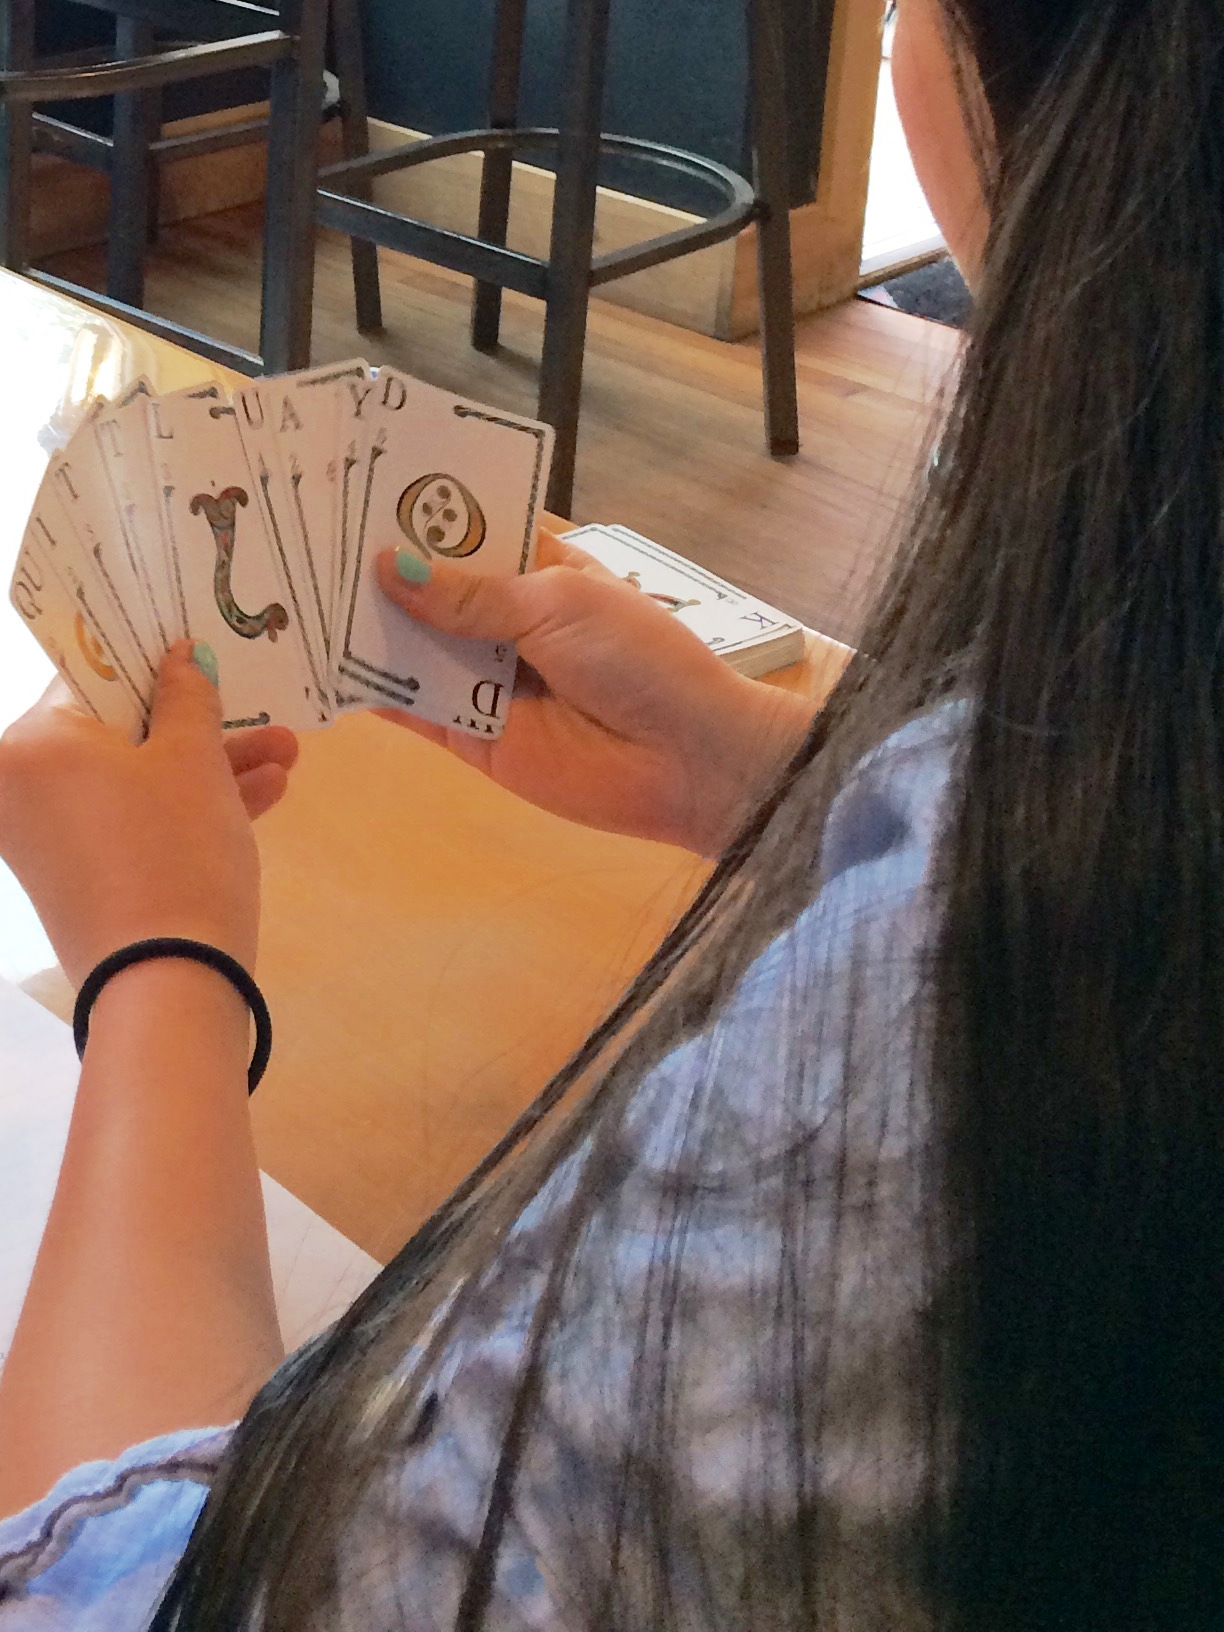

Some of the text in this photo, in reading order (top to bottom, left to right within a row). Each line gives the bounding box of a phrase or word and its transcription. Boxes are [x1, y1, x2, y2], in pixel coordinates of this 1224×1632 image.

[240, 387, 265, 431] U
[347, 380, 374, 419] Y
[379, 376, 408, 411] D
[279, 394, 304, 433] A
[739, 610, 779, 631] K
[471, 678, 505, 720] D
